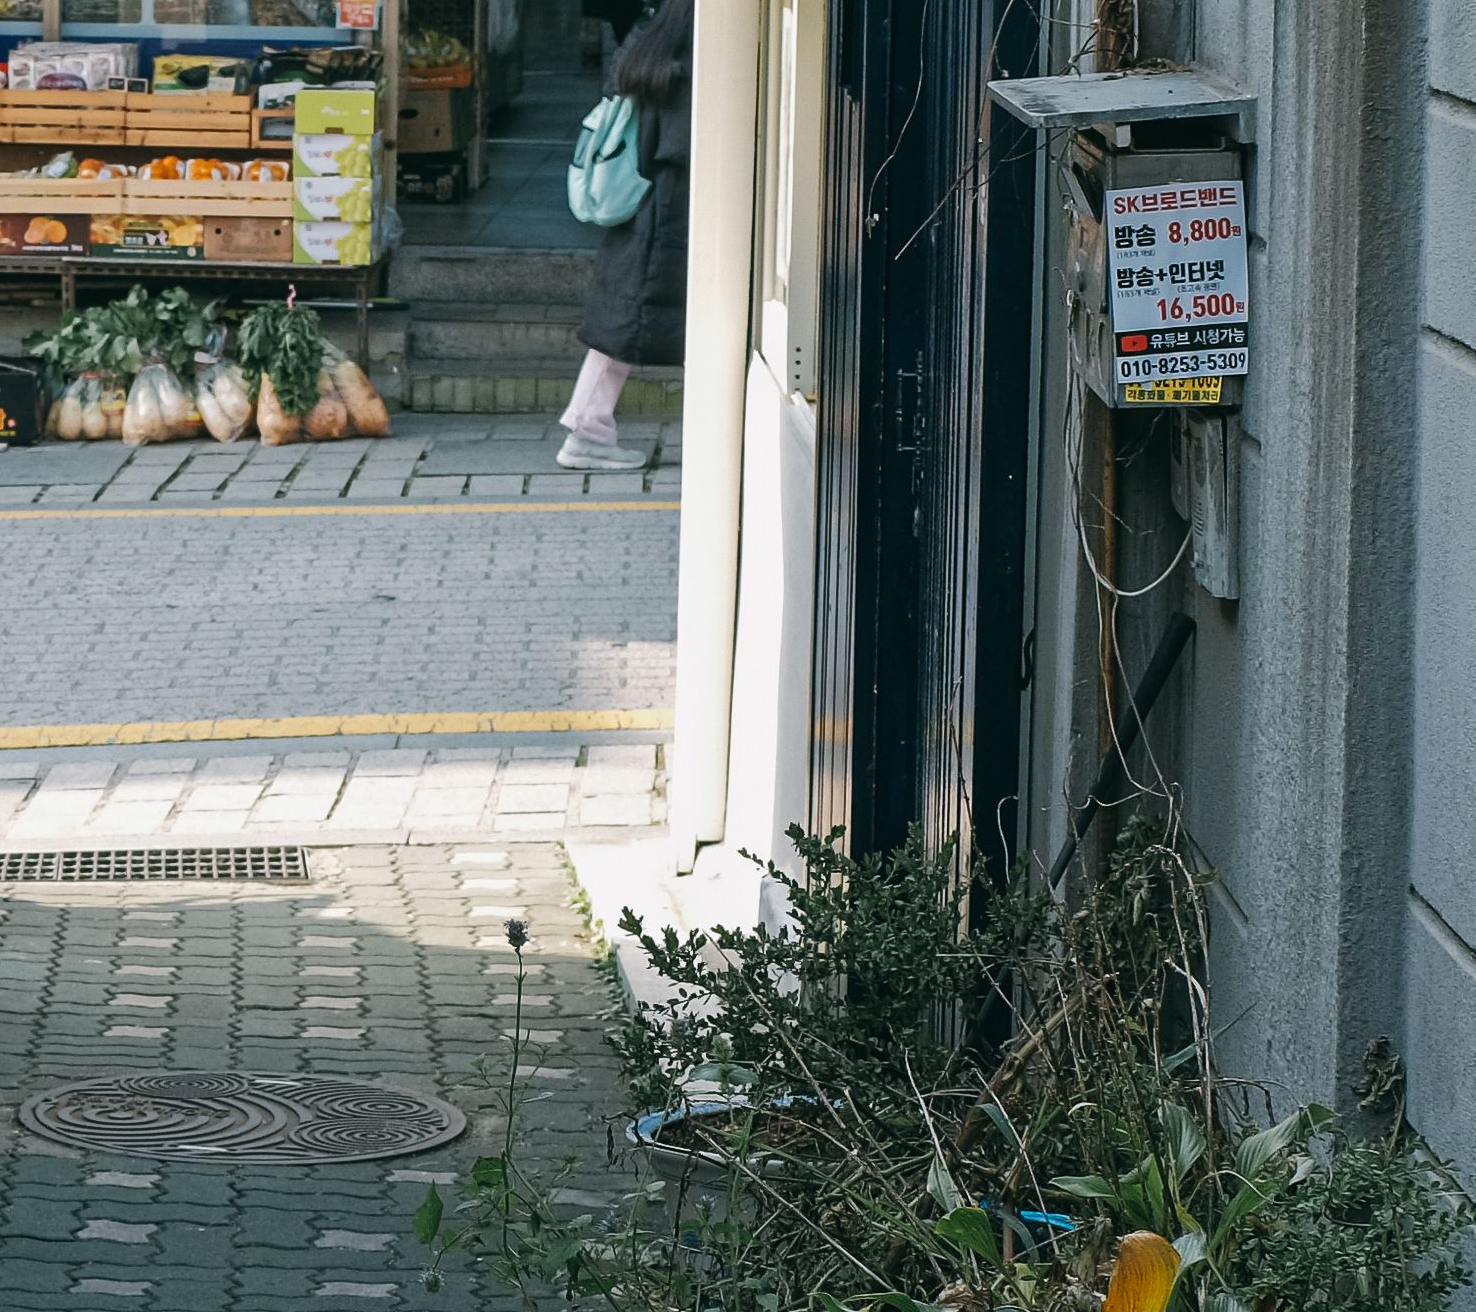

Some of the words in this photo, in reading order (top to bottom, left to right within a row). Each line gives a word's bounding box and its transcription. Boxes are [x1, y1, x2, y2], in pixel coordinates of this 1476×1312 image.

[1113, 187, 1238, 214] SK브로드밴드
[1114, 224, 1156, 249] 방송
[1168, 217, 1242, 247] 8,800원
[1116, 260, 1225, 289] 방송+인터넷
[1156, 292, 1245, 322] 16,500원
[1149, 332, 1190, 350] 유튜브
[1193, 328, 1245, 346] 시청가능
[1120, 351, 1247, 378] 010-8253-5309
